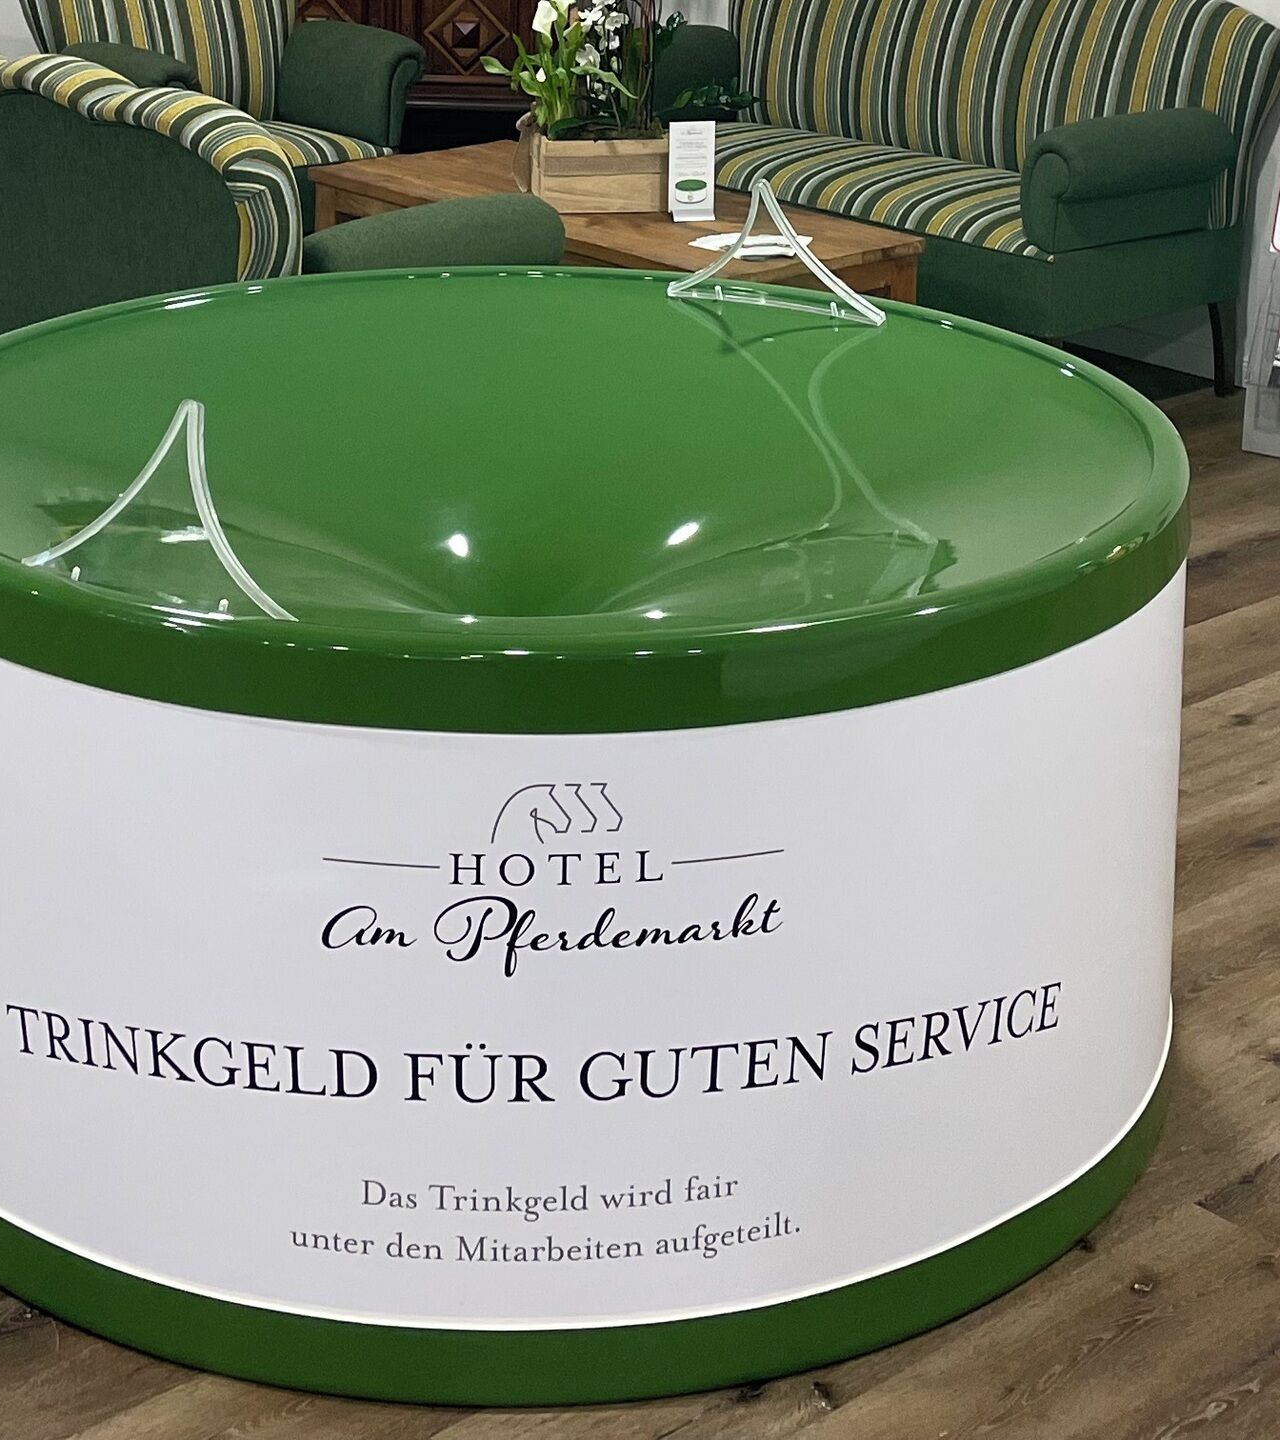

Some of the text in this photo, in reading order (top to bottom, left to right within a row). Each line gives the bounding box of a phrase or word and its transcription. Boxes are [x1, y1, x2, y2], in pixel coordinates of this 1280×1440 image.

[448, 849, 664, 887] HOTEL
[433, 892, 784, 978] Pferdemarkt
[5, 981, 1062, 1104] TRINKGELD FÜR GUTEN SERVICE
[361, 1175, 740, 1223] Das Trinkgeld wird fair
[290, 1211, 801, 1263] unter den Mitarbeiten aufgeteilt.
